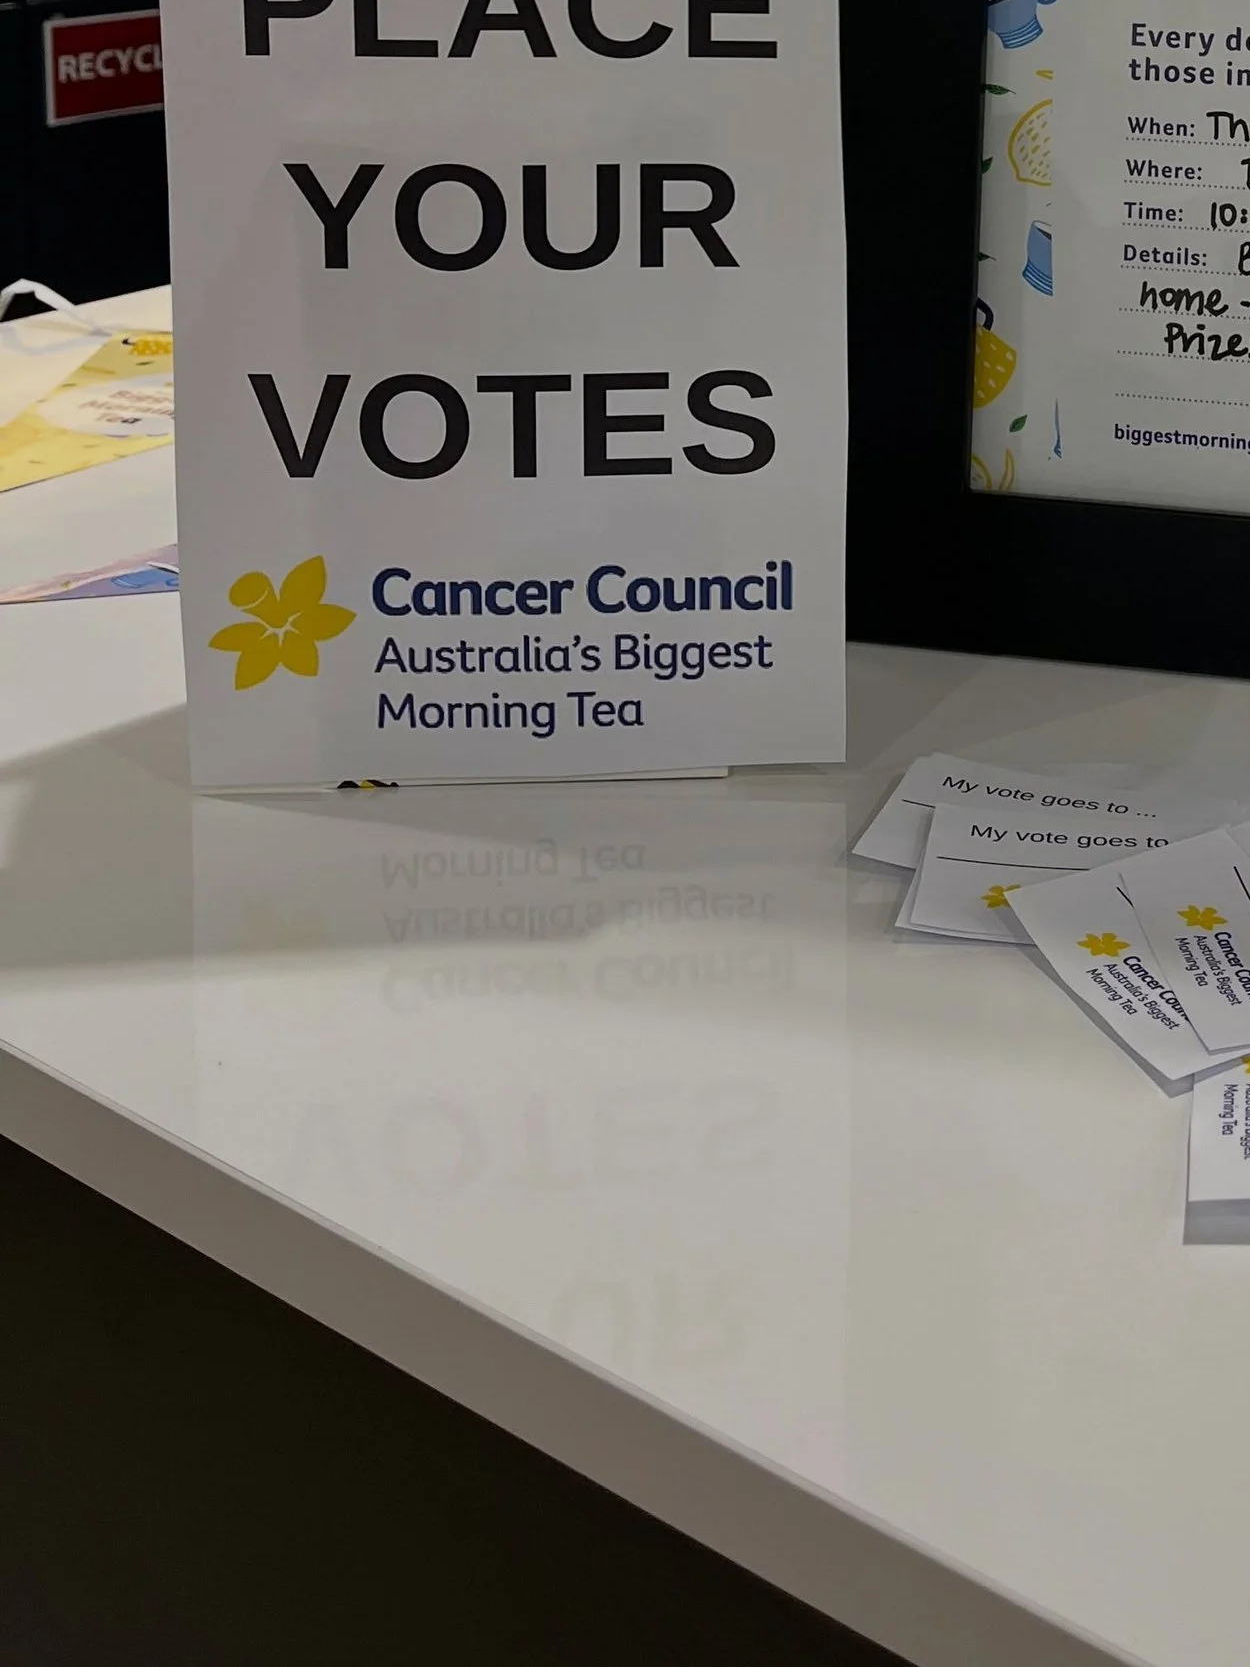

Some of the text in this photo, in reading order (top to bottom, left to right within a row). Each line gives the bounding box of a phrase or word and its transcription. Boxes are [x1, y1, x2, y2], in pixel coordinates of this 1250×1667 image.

[1131, 23, 1215, 57] Every
[57, 43, 163, 84] RECYCL
[1129, 57, 1215, 85] those
[1127, 116, 1196, 137] When:
[1126, 159, 1203, 181] Where:
[283, 162, 740, 271] YOUR
[1123, 202, 1184, 222] Time:
[1123, 244, 1208, 267] Details:
[247, 369, 777, 480] VOTES
[372, 560, 794, 618] Cancer Council
[375, 632, 773, 682] Australia's Biggest
[377, 692, 644, 738] Morning Tea
[942, 776, 979, 794] My
[985, 786, 1035, 802] vote
[1040, 794, 1099, 812] goes
[1106, 800, 1130, 815] to
[970, 824, 1169, 848] My vote goes to
[1174, 937, 1209, 987] Morning Tea
[1193, 934, 1243, 1006] Australia's Biggest
[1214, 931, 1243, 969] Cancer
[1086, 967, 1138, 1016] Morning Tea
[1104, 962, 1181, 1031] Australia's Biggest
[1123, 954, 1191, 1022] Cancer Coun
[1218, 1084, 1239, 1136] Morning Tea
